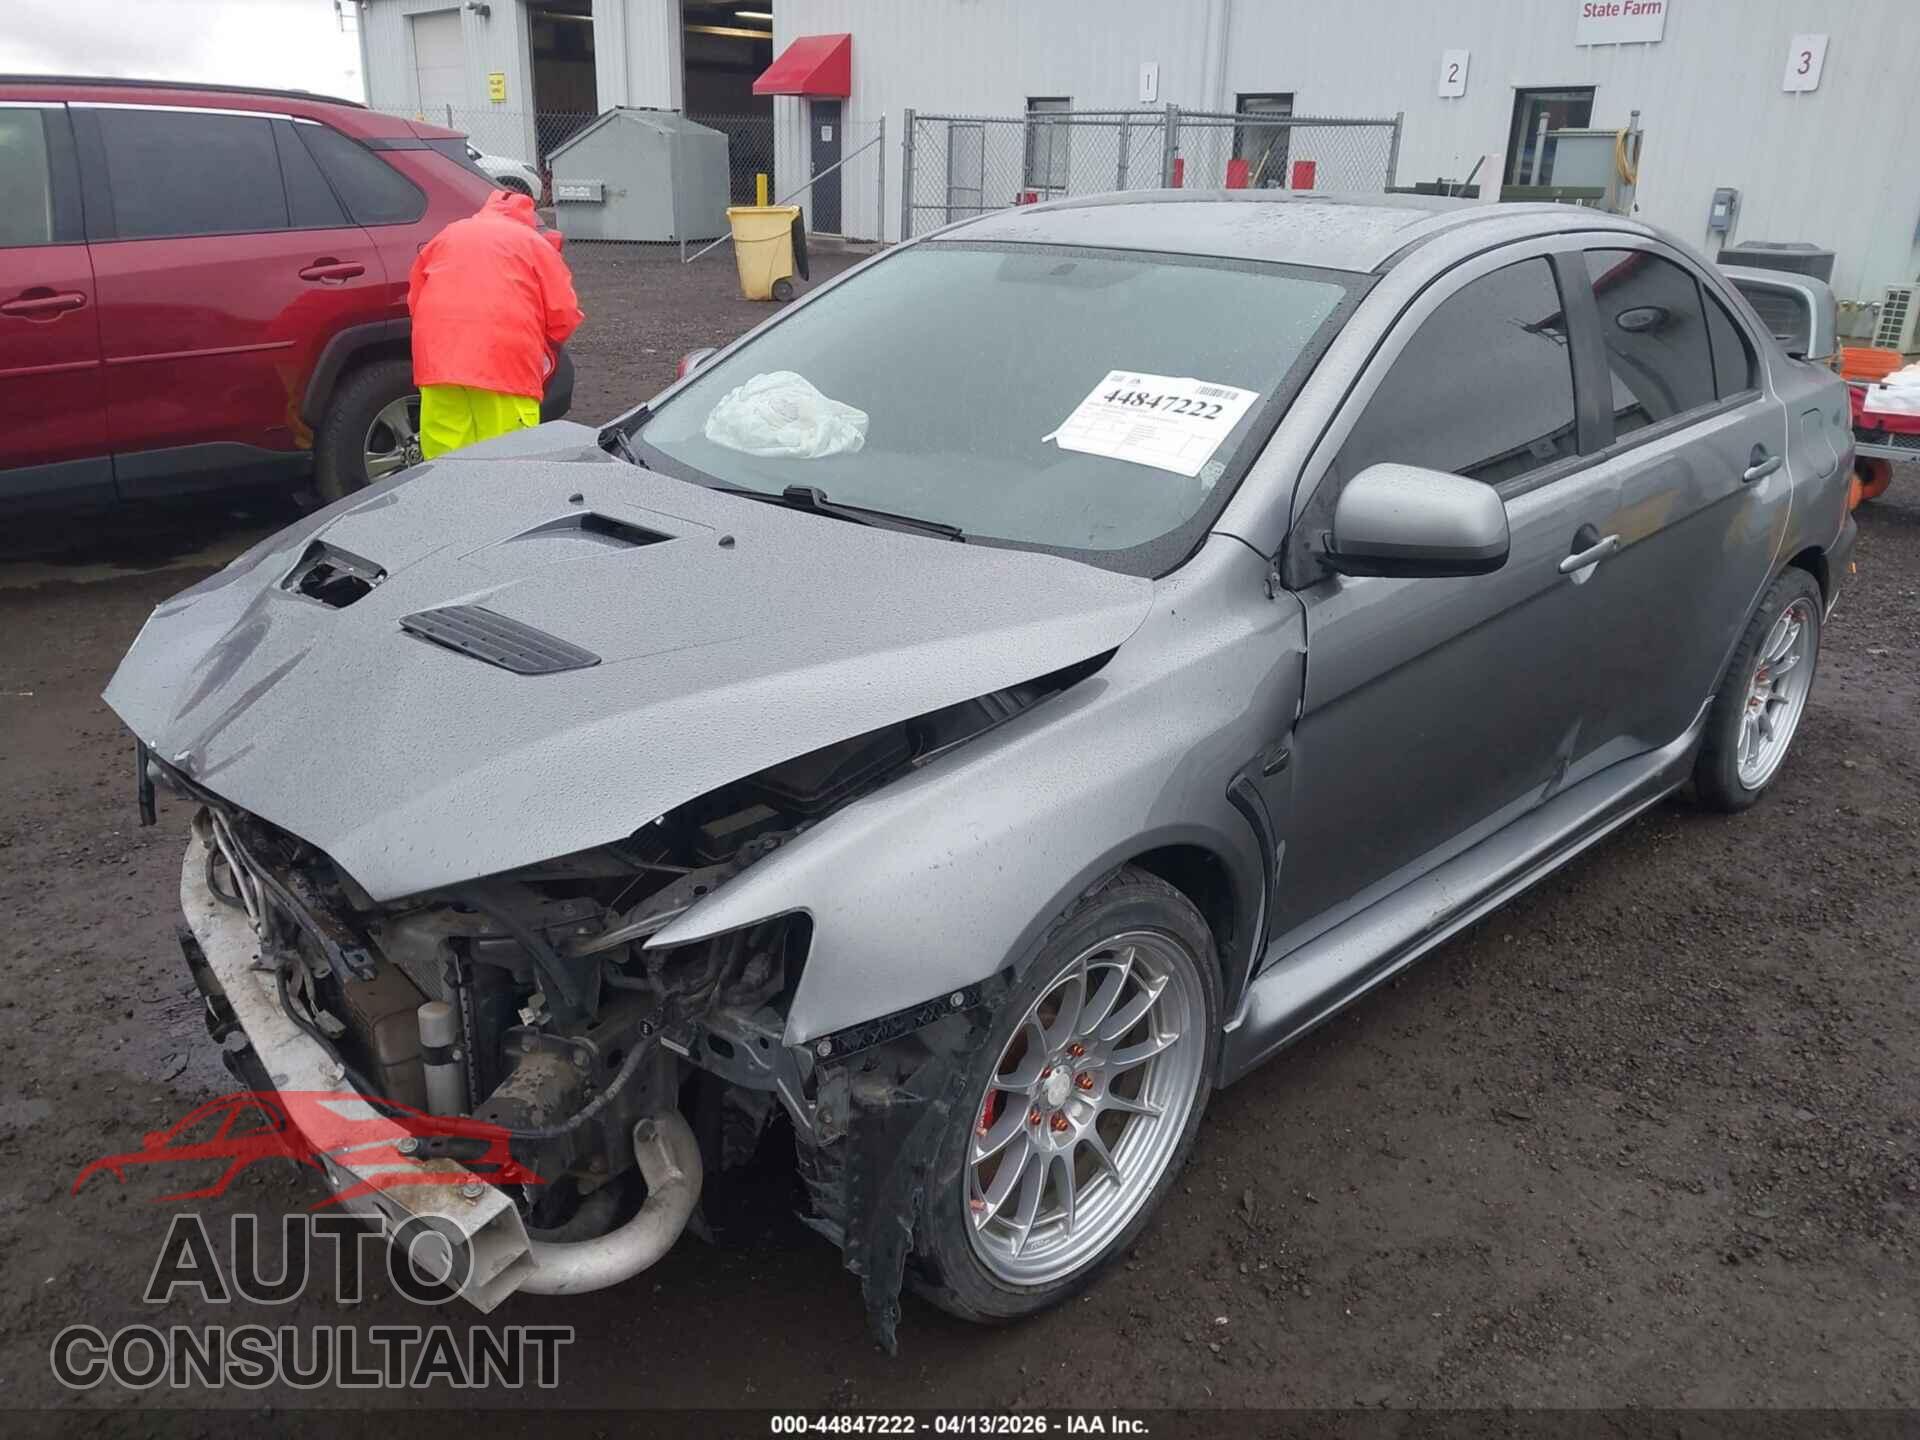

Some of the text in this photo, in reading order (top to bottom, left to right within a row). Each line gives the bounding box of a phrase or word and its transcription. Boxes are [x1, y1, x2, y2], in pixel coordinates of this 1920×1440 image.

[1583, 0, 1662, 17] State Farm
[1447, 63, 1459, 83] 2
[1797, 50, 1812, 75] 3
[1103, 388, 1223, 420] 44847222
